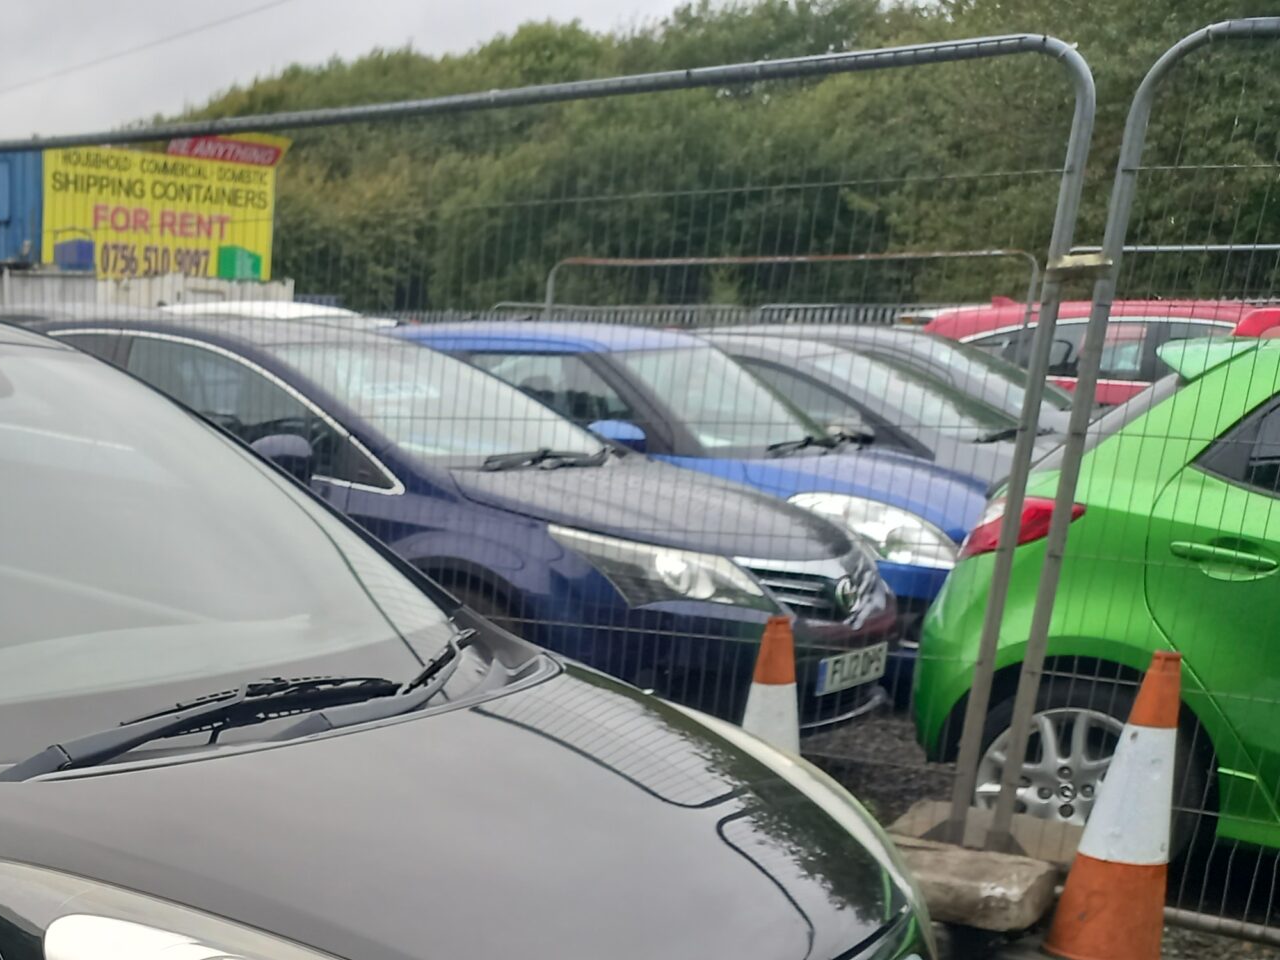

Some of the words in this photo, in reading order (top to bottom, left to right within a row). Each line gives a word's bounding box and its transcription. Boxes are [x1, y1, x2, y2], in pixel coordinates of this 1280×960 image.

[192, 140, 277, 165] ANYTHING
[140, 157, 208, 180] COMMERCIAL
[217, 166, 269, 186] DOMESTIC
[52, 171, 146, 200] SHIPPING
[150, 179, 268, 210] CONTAINERS
[93, 203, 150, 235] FOR
[159, 210, 231, 241] RENT
[100, 241, 139, 275] 0756
[143, 244, 171, 276] 510
